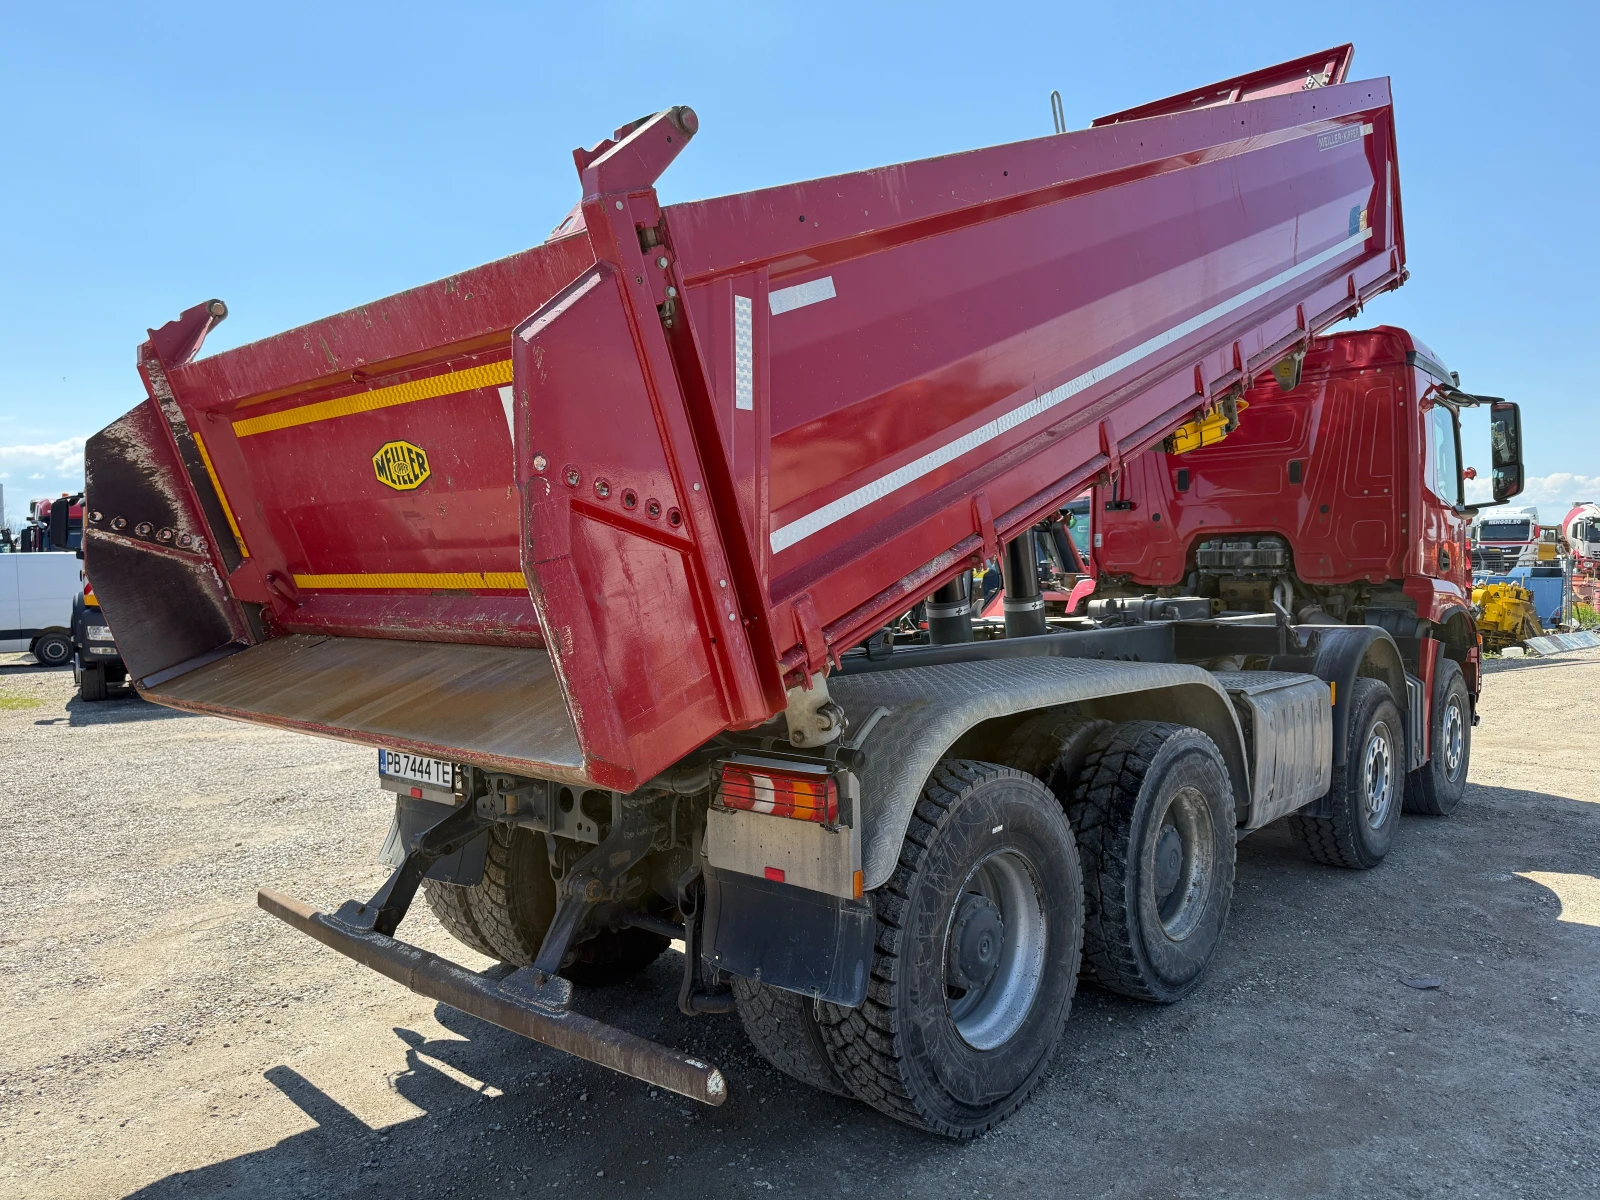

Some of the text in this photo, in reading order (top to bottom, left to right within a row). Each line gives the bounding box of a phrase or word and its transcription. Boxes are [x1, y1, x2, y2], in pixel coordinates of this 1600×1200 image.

[375, 446, 427, 485] MEILLER
[387, 752, 450, 784] PB 7444 TE
